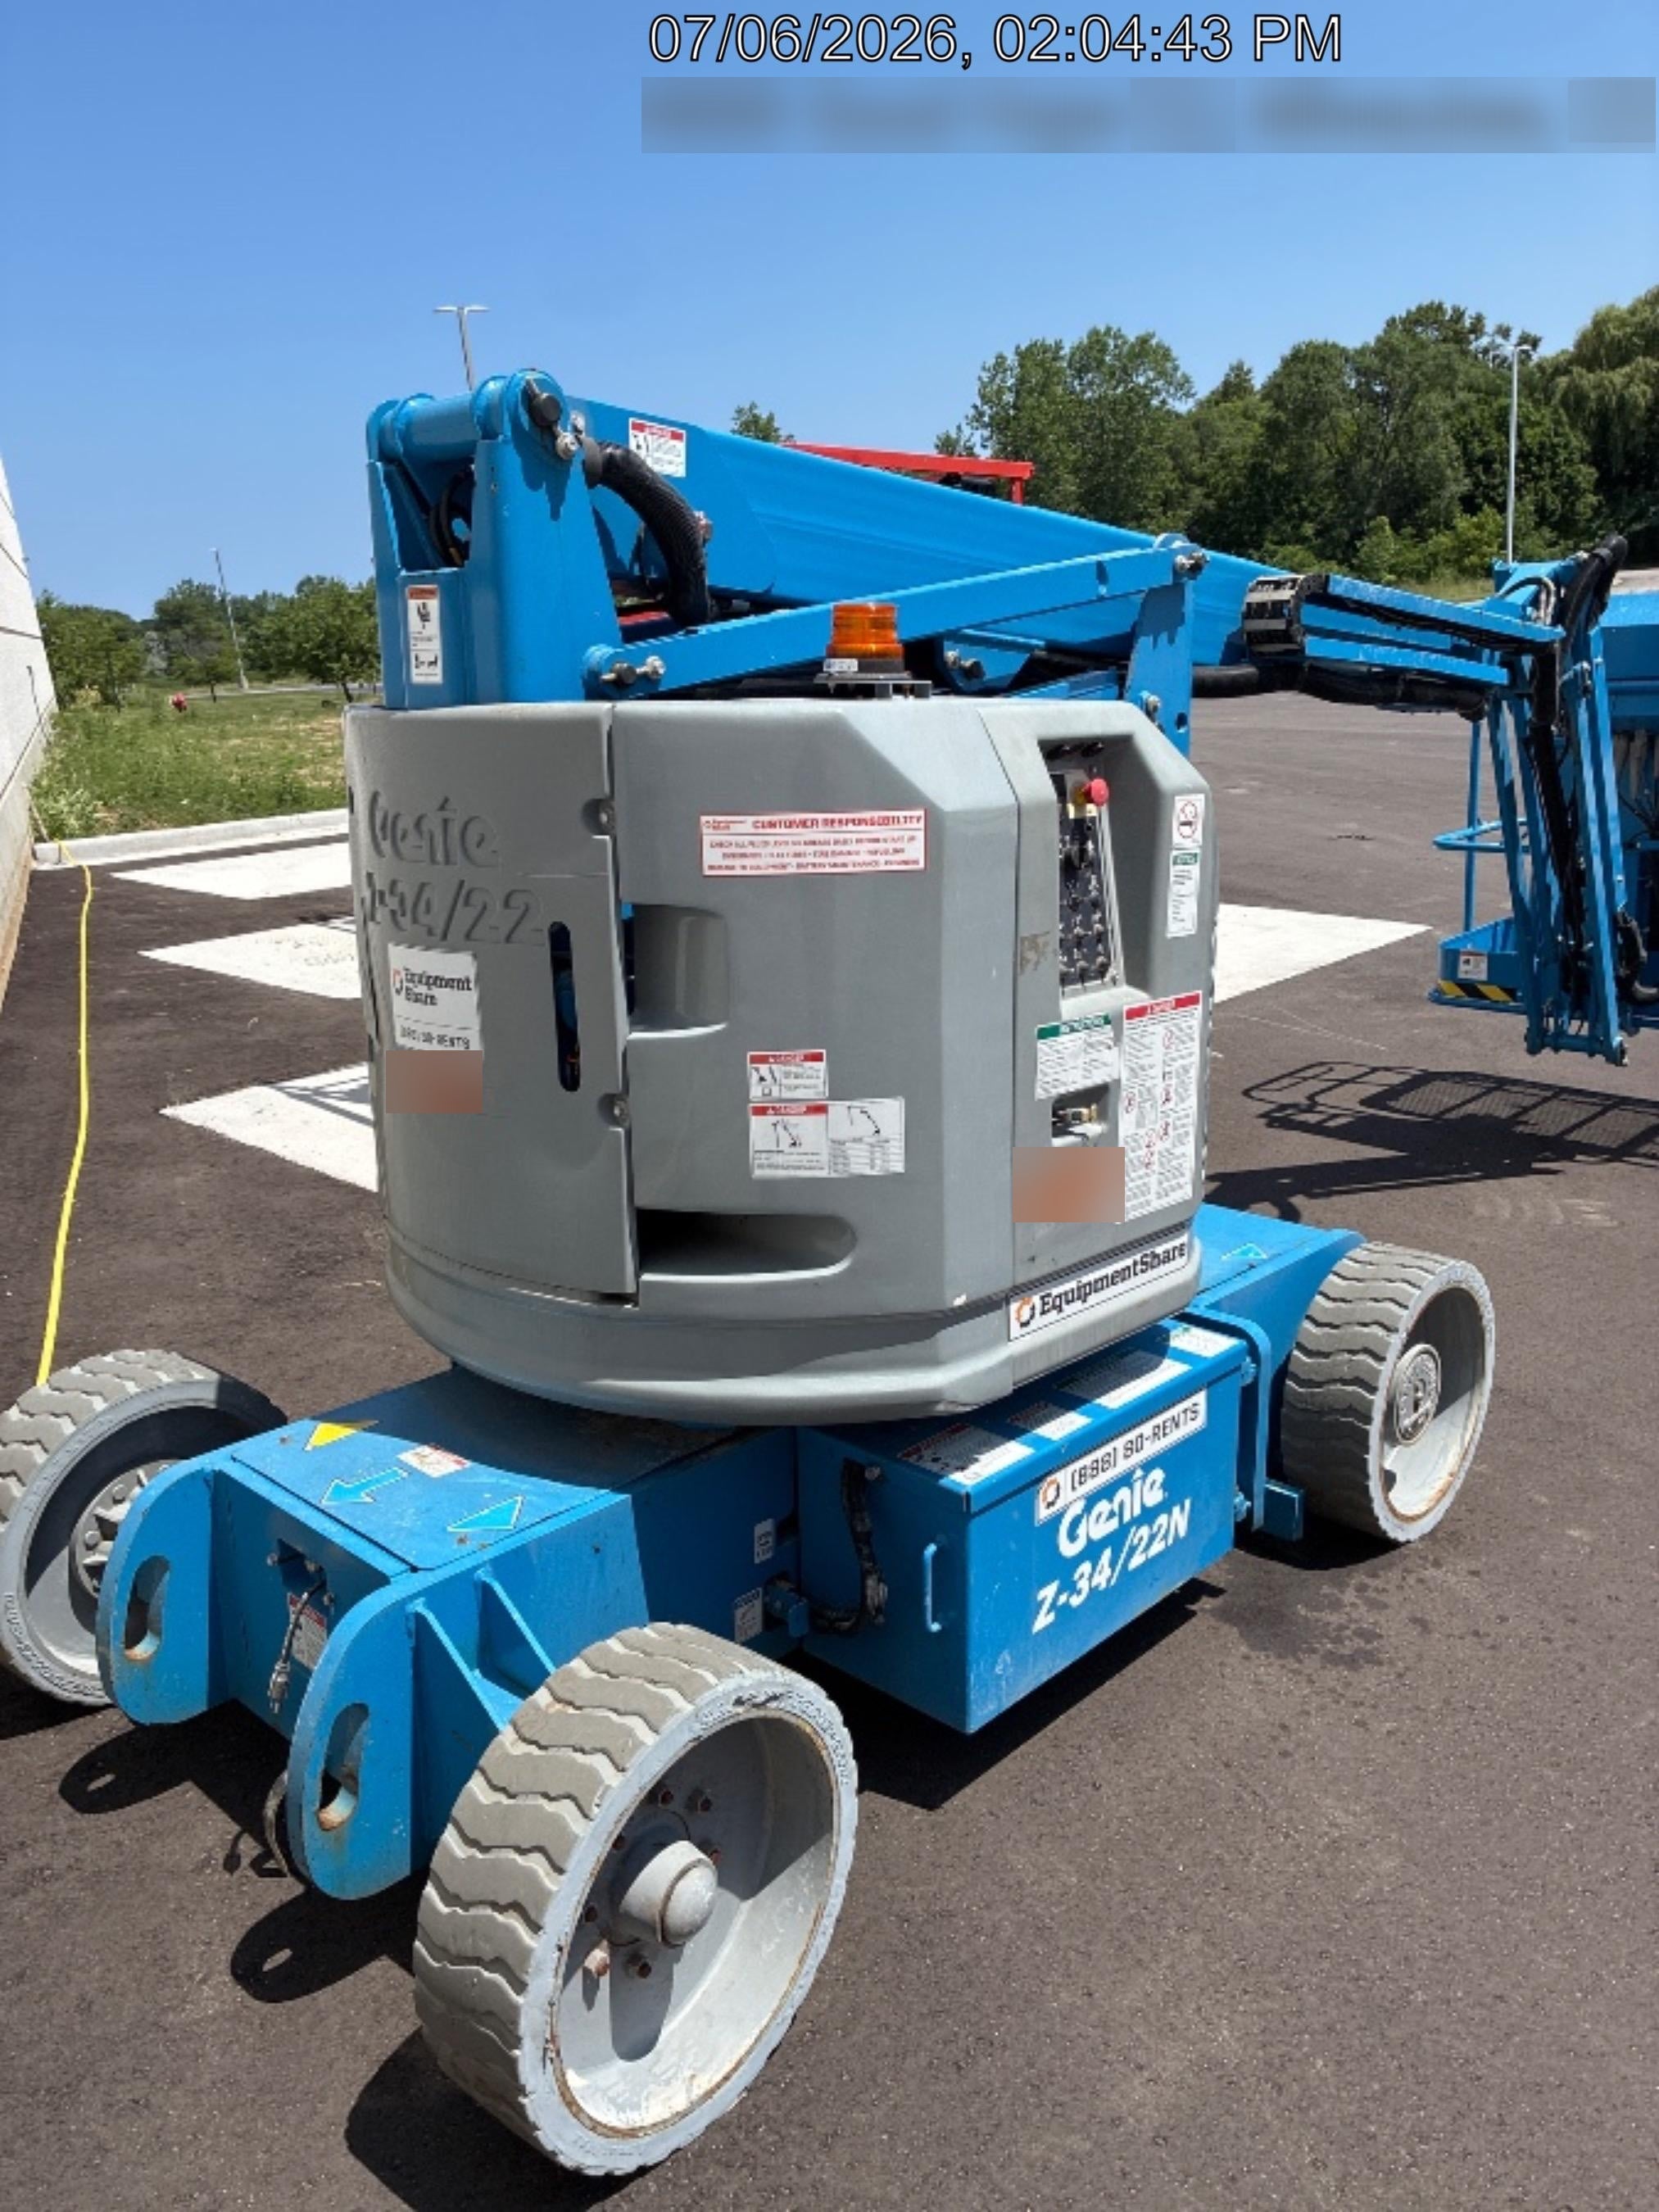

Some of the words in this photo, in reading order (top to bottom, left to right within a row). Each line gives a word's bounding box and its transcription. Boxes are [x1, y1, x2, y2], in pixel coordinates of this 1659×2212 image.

[1039, 1242, 1186, 1315] EquipmentShare
[1057, 1467, 1167, 1557] Genie
[1032, 1498, 1192, 1635] Z-34/22N
